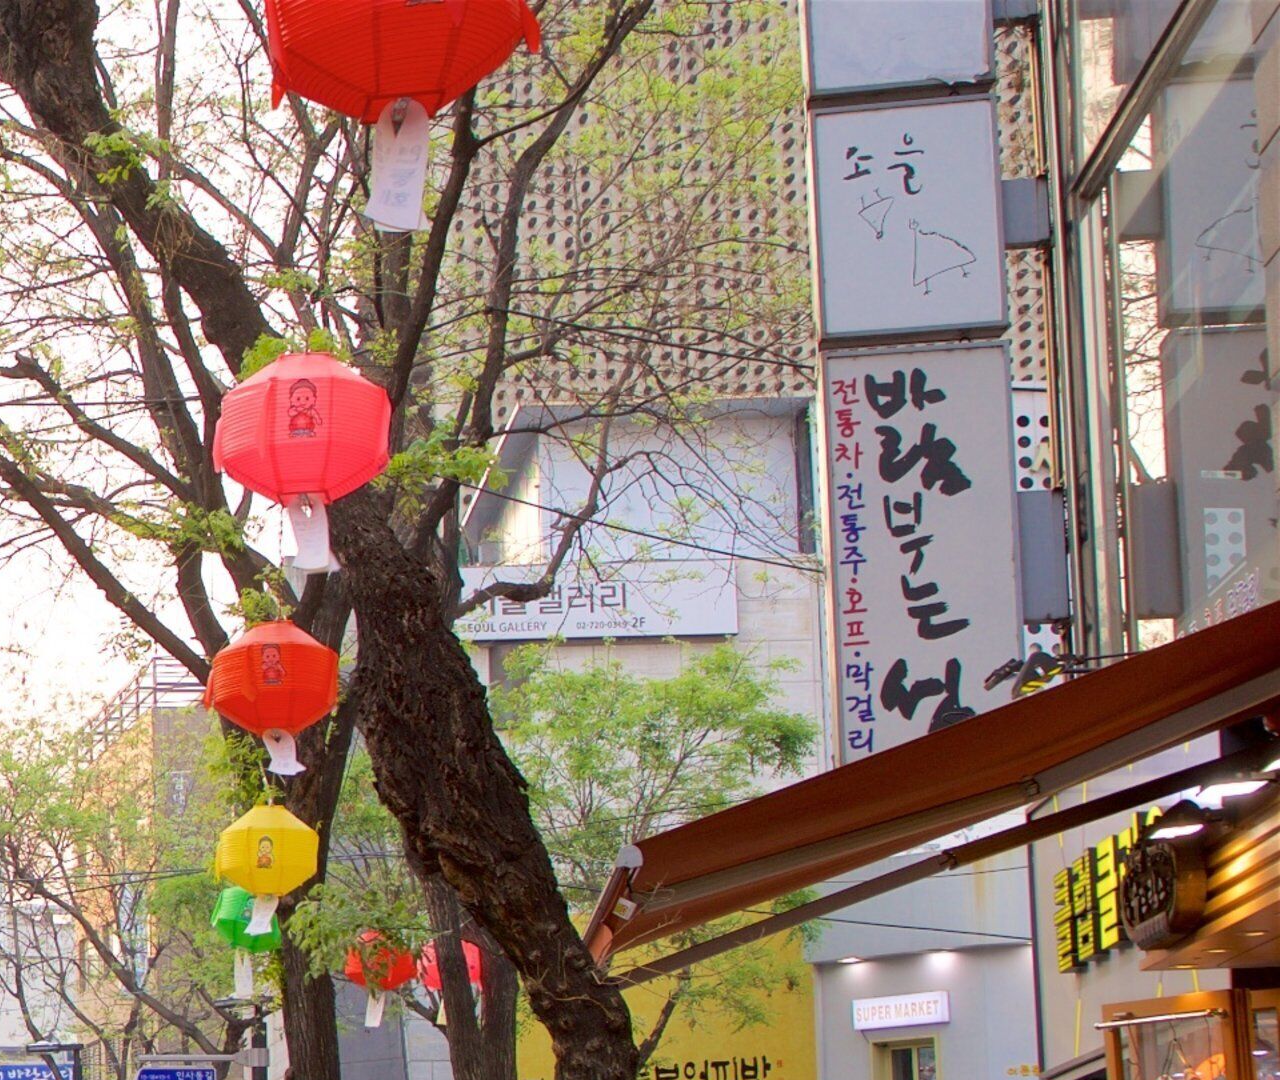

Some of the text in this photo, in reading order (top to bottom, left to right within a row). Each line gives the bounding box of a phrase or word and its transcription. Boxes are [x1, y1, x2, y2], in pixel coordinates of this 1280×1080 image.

[539, 582, 627, 614] 갤러리
[499, 621, 547, 633] GALLERY
[631, 616, 646, 629] 2F
[856, 999, 939, 1023] SUPER MARKET
[175, 1071, 214, 1080] 인사동길
